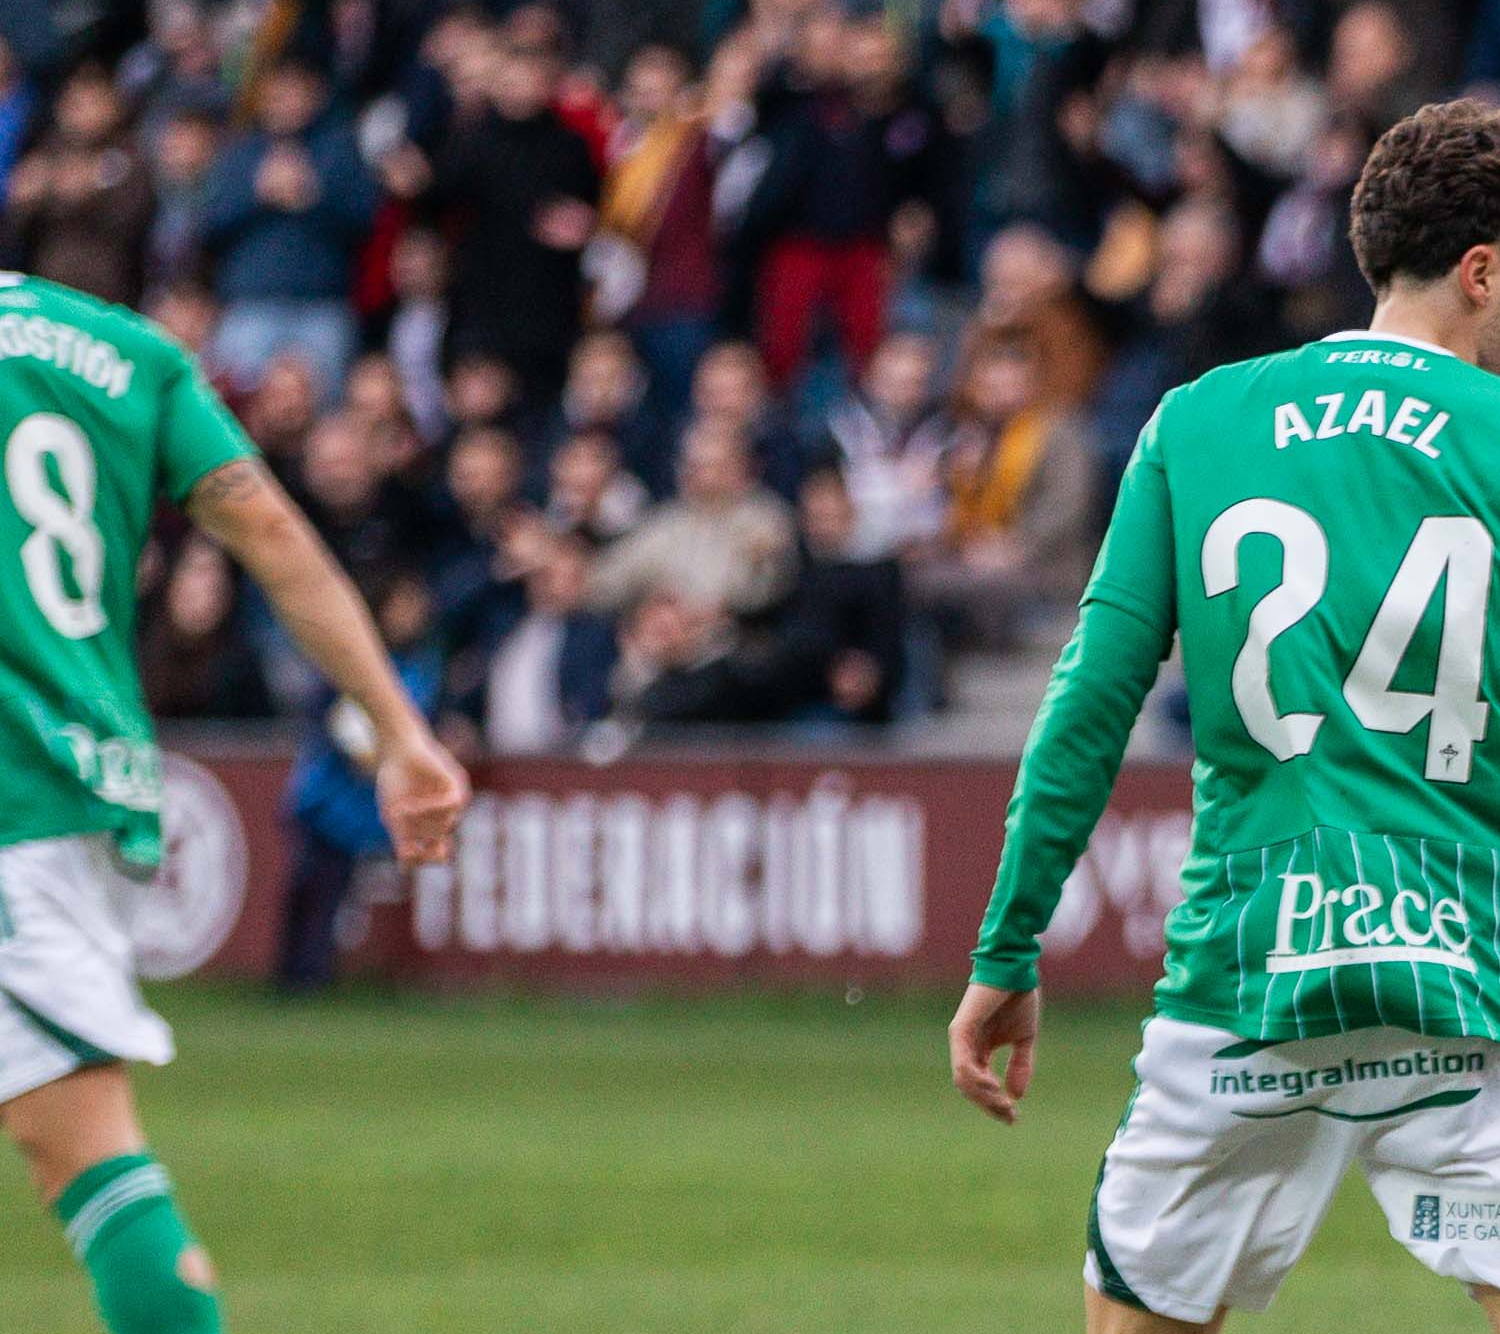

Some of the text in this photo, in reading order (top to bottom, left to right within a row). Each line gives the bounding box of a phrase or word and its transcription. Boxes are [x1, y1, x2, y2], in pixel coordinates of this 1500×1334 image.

[1274, 390, 1451, 459] AZAEL
[4, 411, 107, 640] 8
[1201, 497, 1494, 783] 24
[1274, 873, 1473, 959] Prace
[1211, 1049, 1485, 1098] integralmotion
[1446, 1222, 1468, 1242] DE
